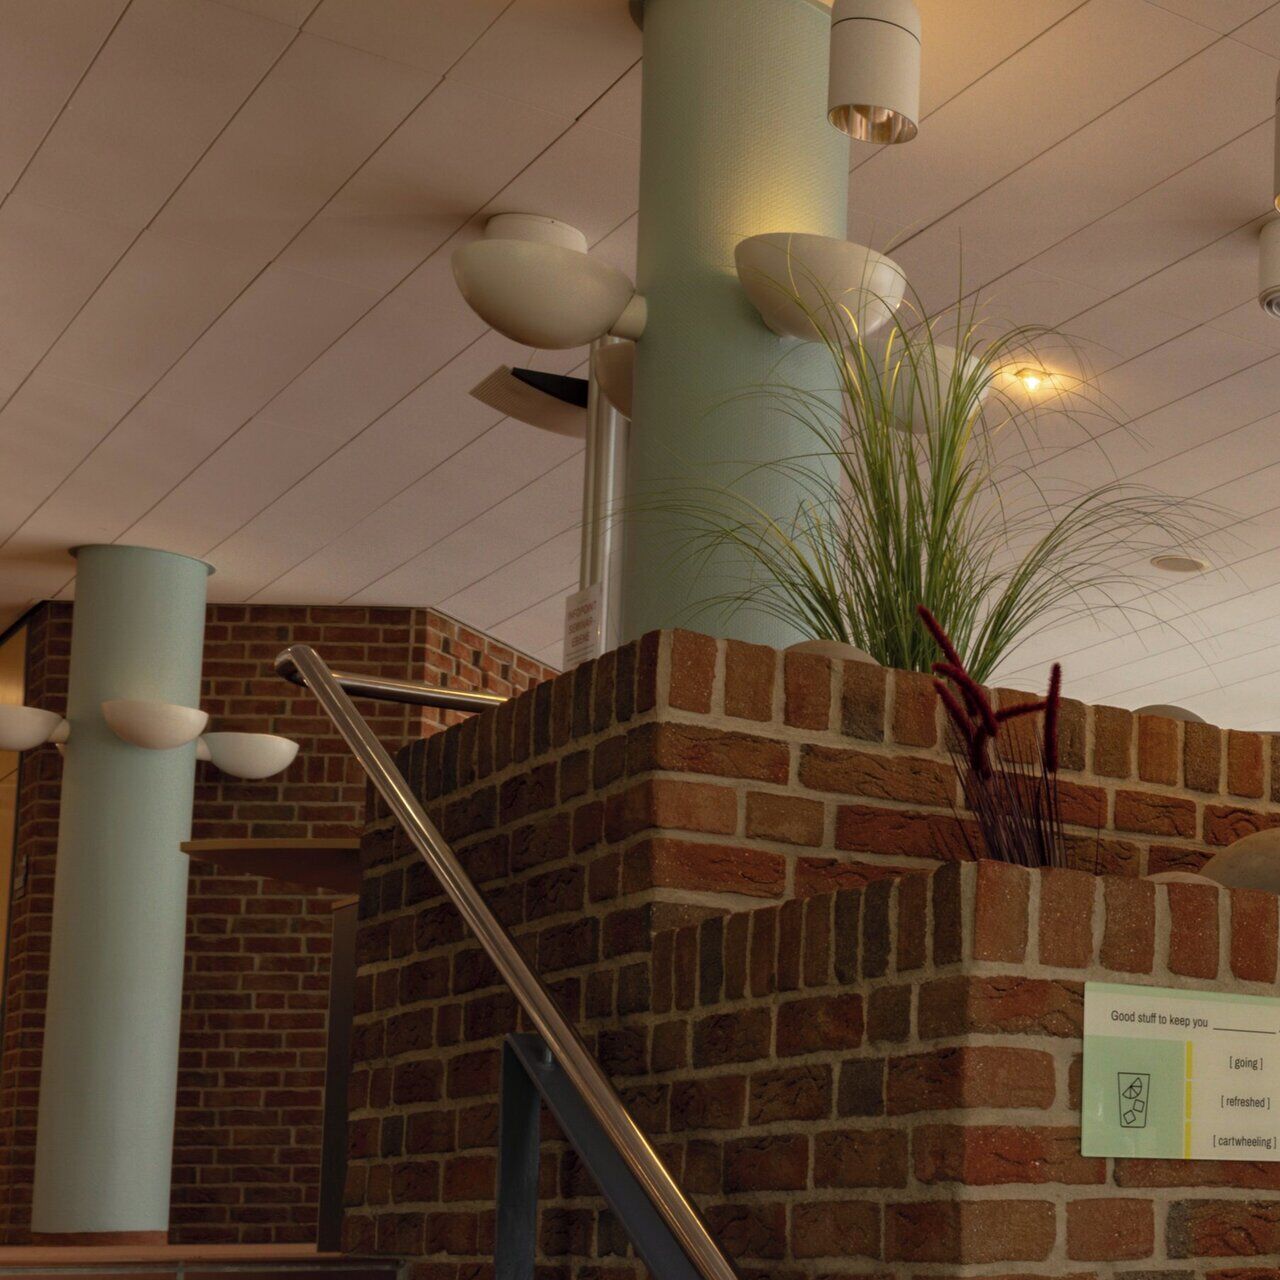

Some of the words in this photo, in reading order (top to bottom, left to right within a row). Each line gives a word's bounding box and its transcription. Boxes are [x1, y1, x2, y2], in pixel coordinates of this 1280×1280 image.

[1111, 1010, 1135, 1022] Good
[1138, 1012, 1156, 1024] stuff
[1158, 1014, 1167, 1025] to
[1169, 1015, 1190, 1028] keep
[1192, 1017, 1208, 1028] you
